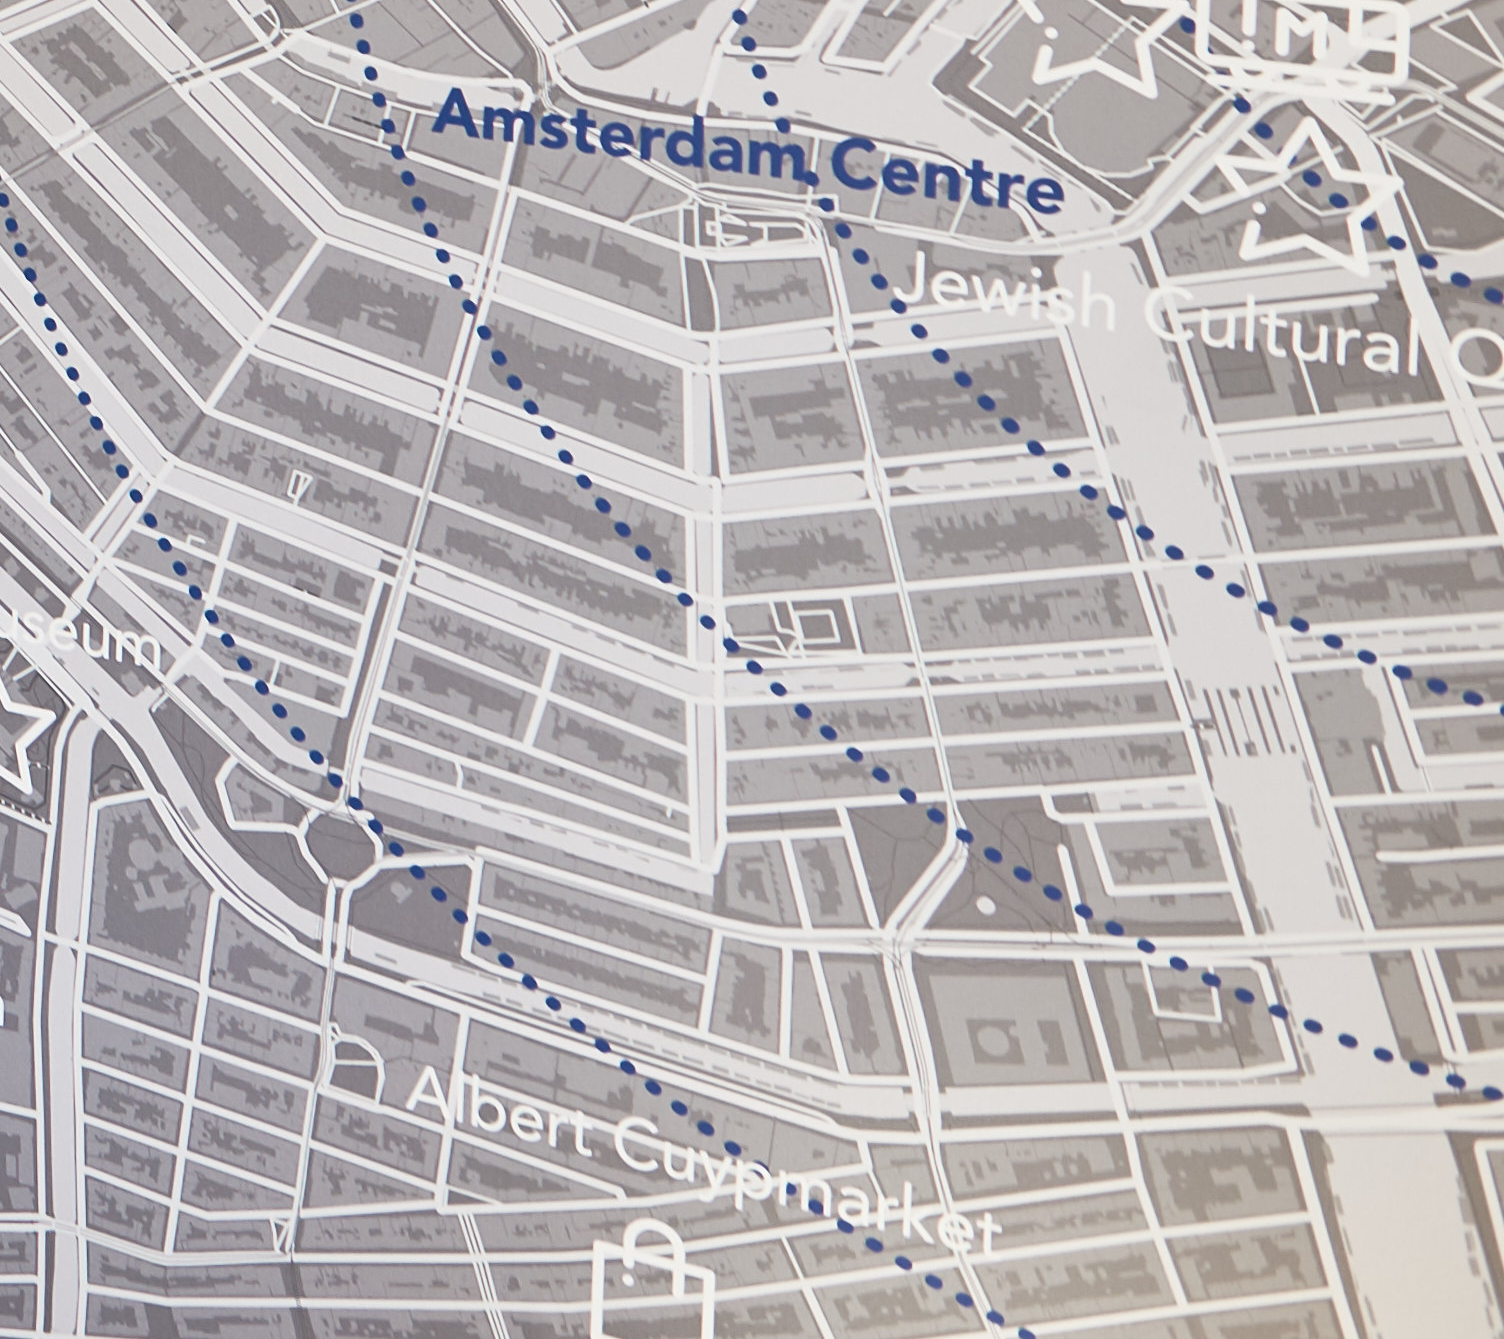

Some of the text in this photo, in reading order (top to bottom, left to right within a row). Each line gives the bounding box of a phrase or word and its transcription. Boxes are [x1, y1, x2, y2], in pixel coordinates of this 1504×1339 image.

[431, 87, 1066, 215] Amsterdam Centre
[892, 250, 1116, 332] Jewish
[1144, 285, 1420, 377] Cultural
[405, 1065, 1003, 1255] Albert Cuypmarket
